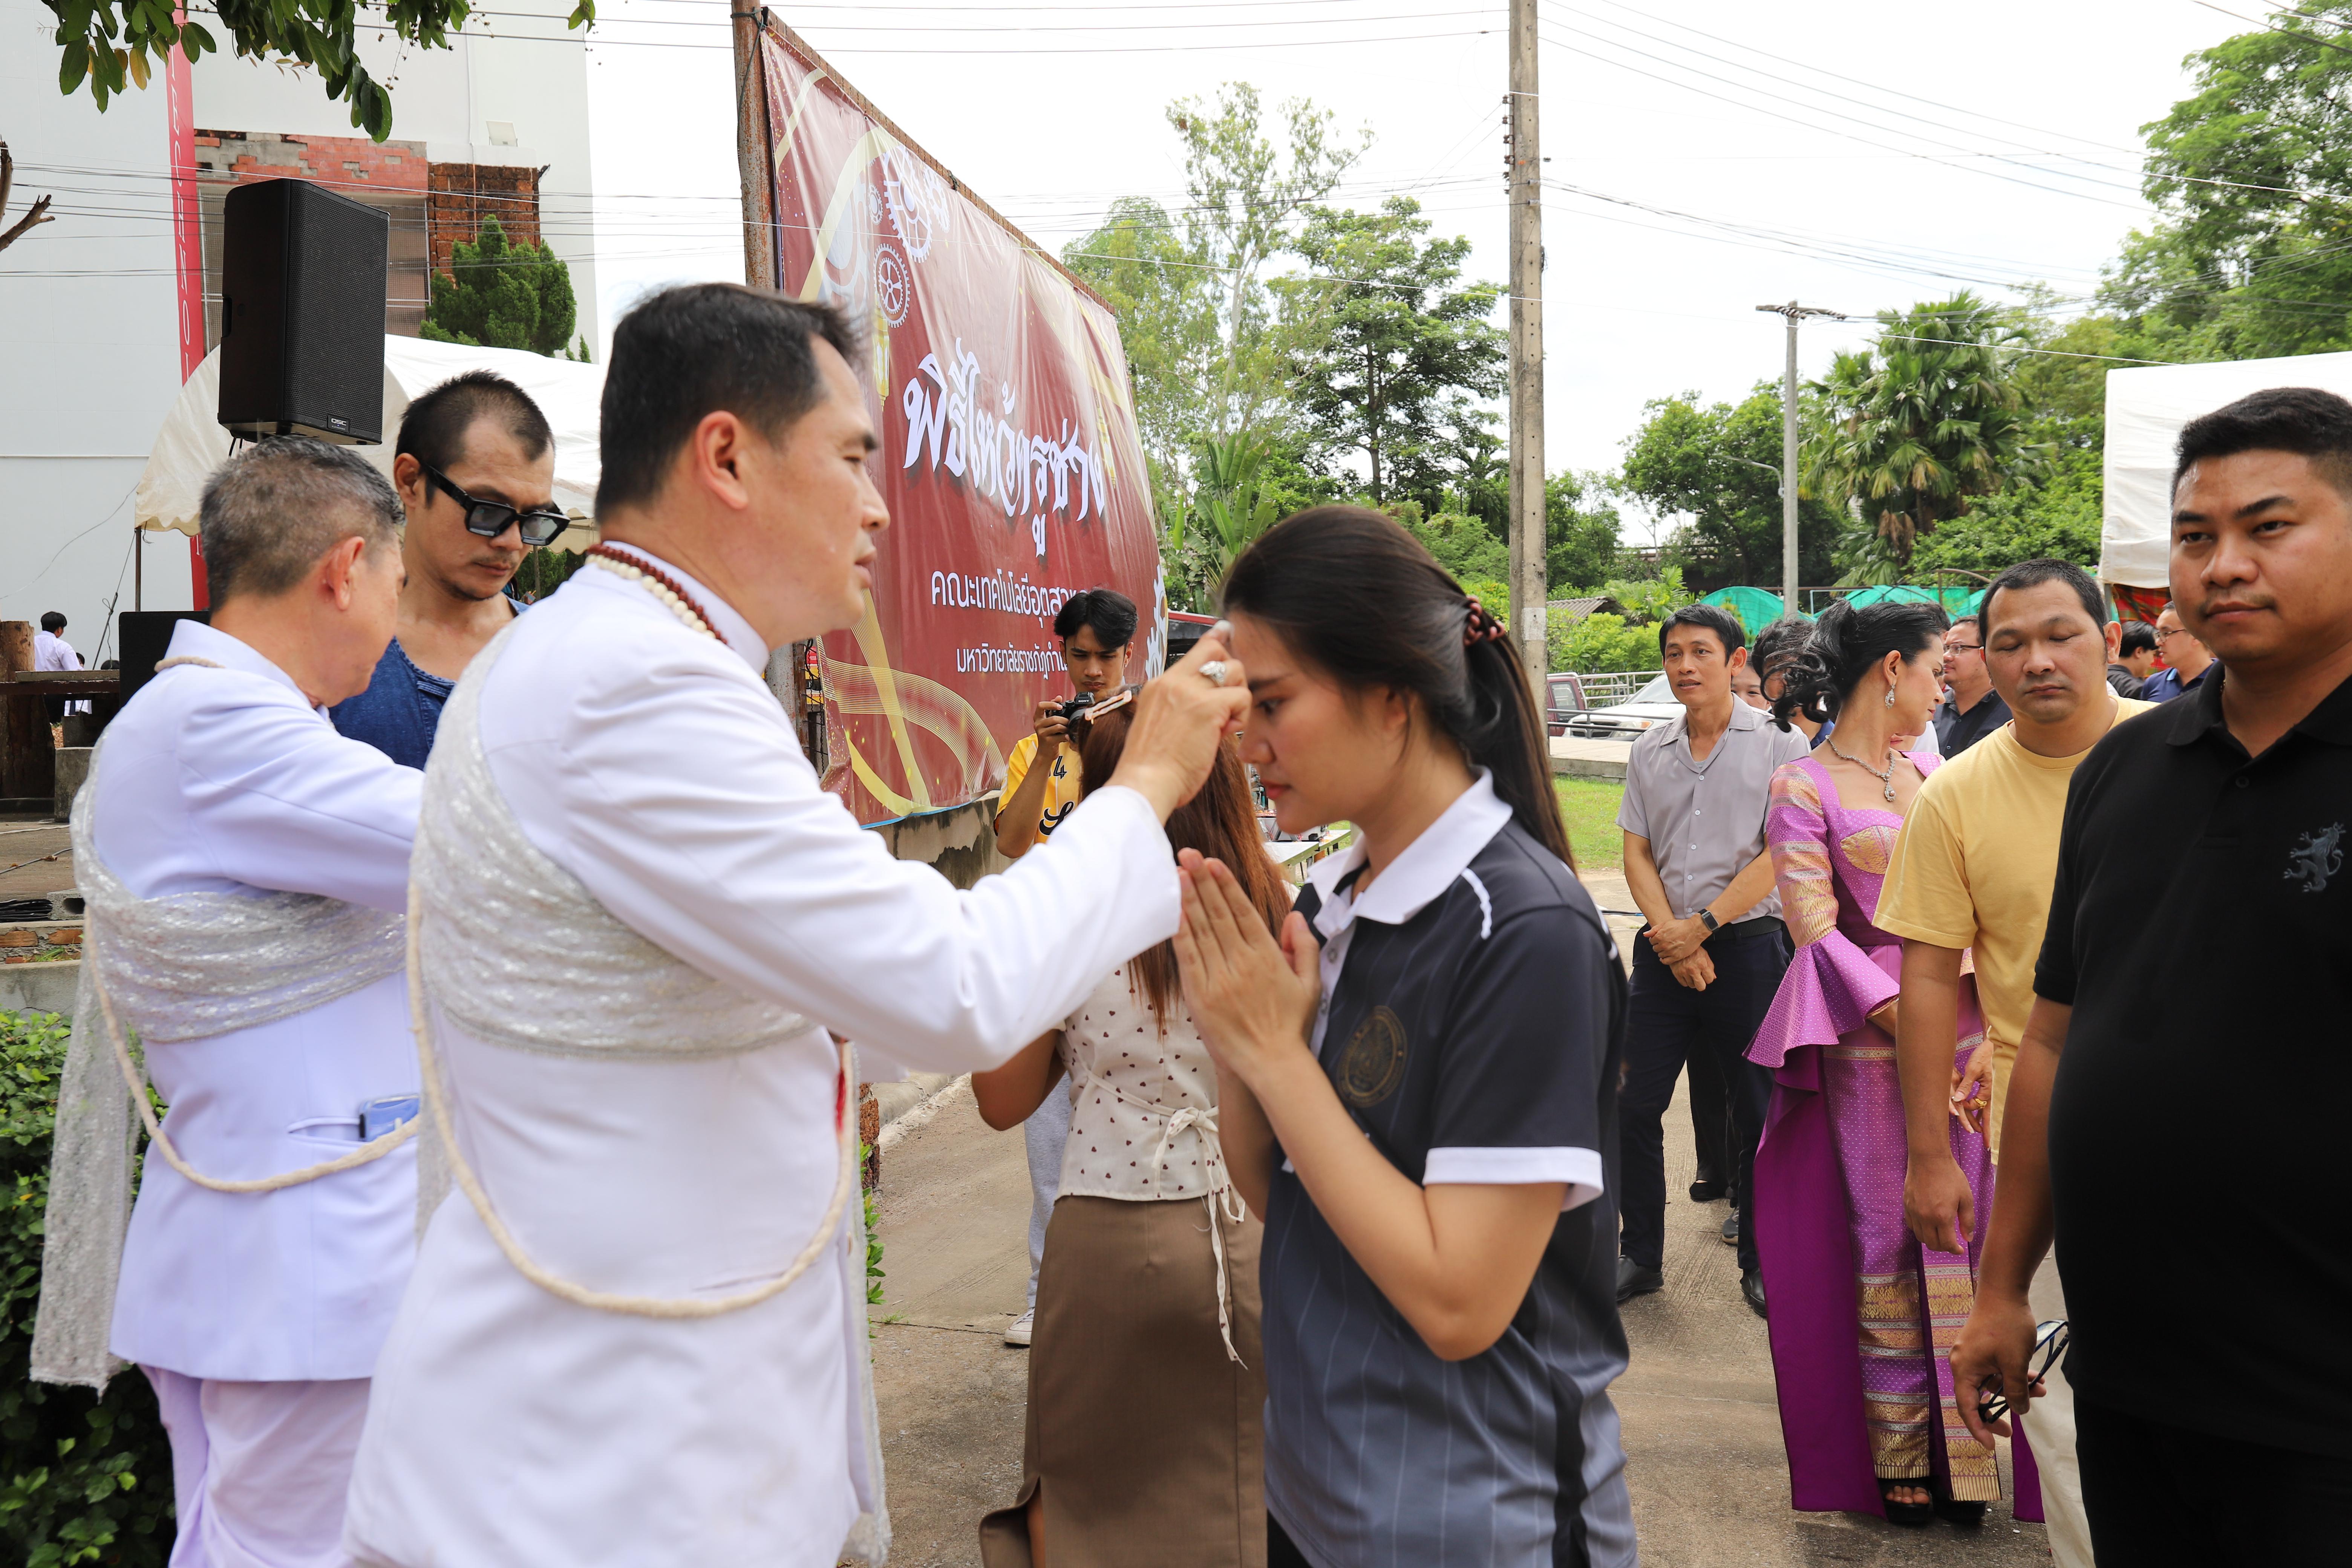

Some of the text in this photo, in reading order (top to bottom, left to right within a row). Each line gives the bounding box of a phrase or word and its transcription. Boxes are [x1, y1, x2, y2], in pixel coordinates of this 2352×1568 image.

[903, 338, 1105, 558] พิธีไหว้ครูช่าง
